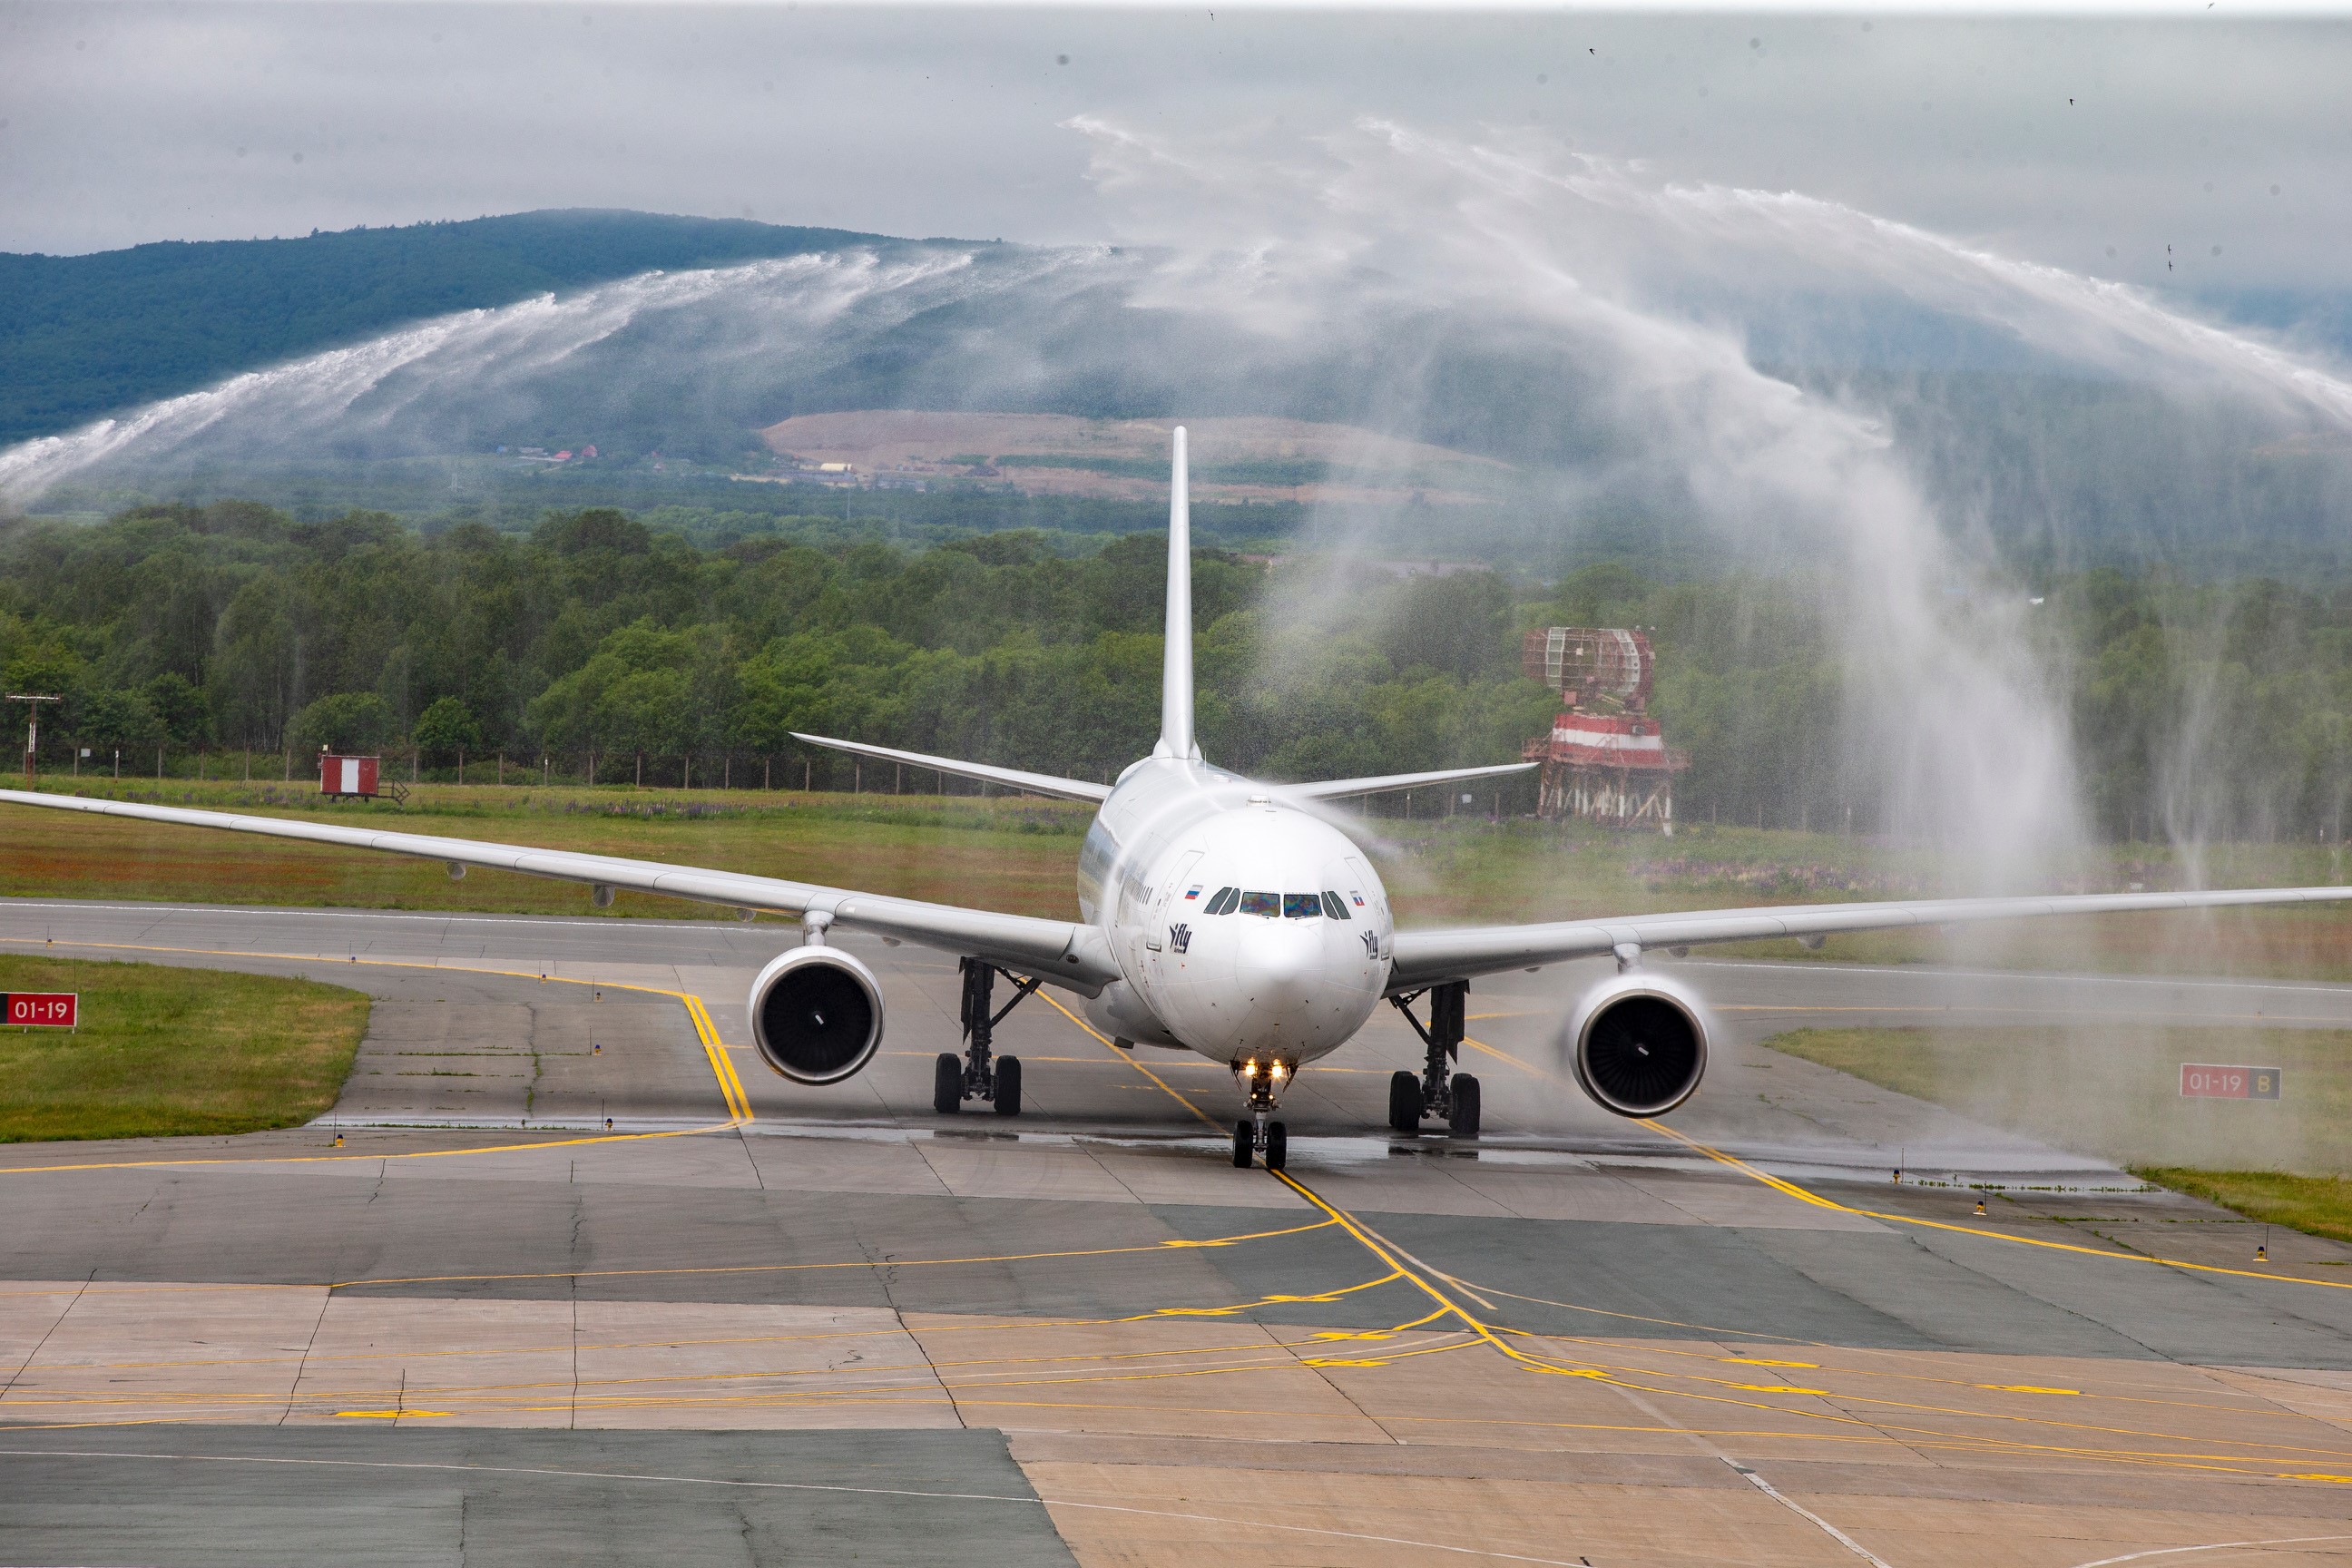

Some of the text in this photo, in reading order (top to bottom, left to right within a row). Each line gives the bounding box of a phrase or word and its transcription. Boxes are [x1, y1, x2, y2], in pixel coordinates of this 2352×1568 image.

[15, 1001, 67, 1018] 01-19
[2190, 1073, 2270, 1093] 01-19 B
